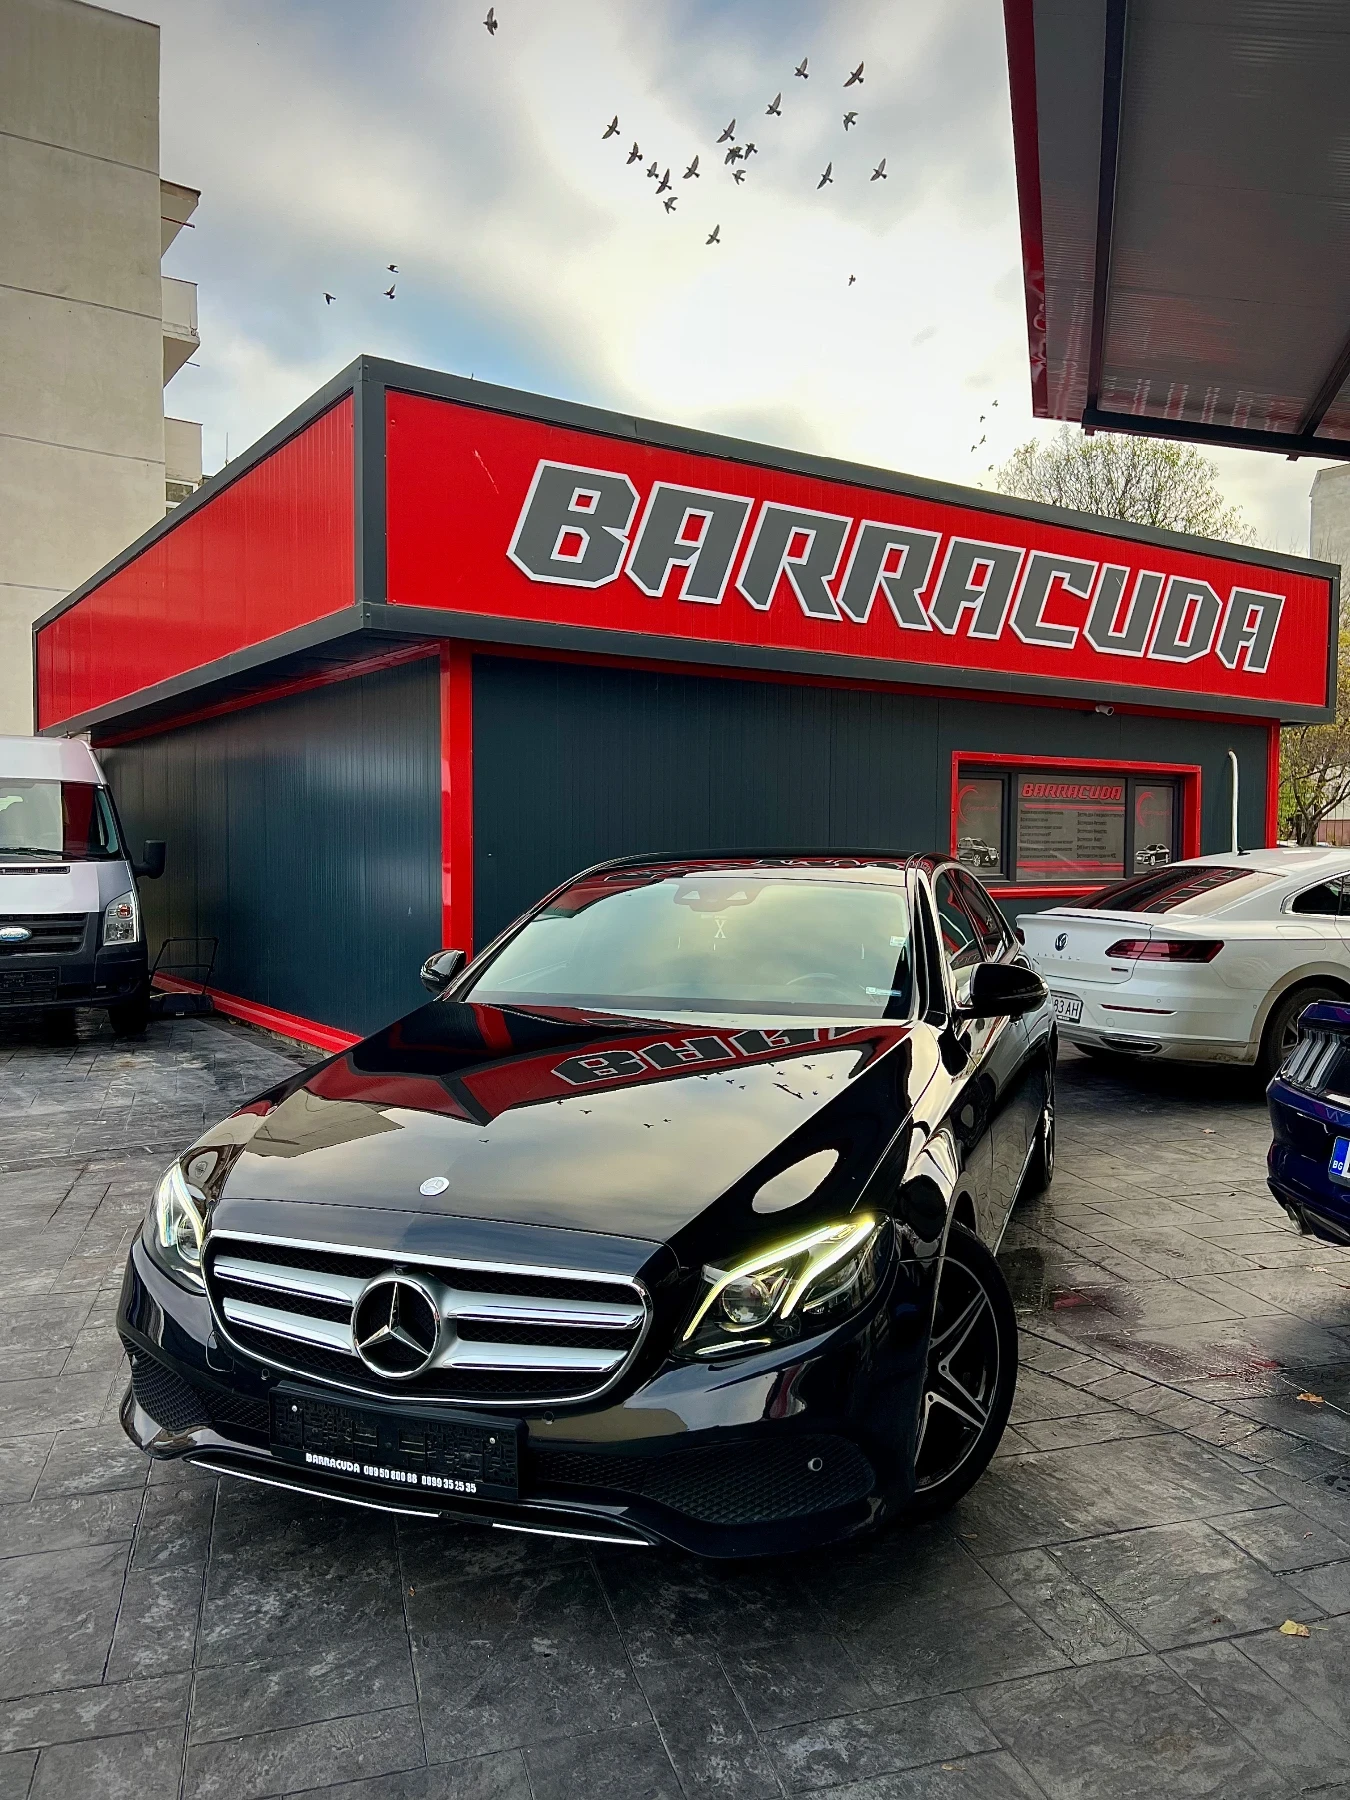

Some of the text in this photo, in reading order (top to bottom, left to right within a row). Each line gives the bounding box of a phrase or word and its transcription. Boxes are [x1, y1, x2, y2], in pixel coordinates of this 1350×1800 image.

[505, 458, 1286, 674] BARRACUDA
[1022, 783, 1122, 801] BARRACUDA
[1065, 1001, 1080, 1017] AH
[1332, 1160, 1343, 1171] BG
[305, 1452, 360, 1473] BARRACUDA
[379, 1468, 390, 1478] 50
[406, 1473, 418, 1484] 88
[443, 1478, 454, 1490] 35
[454, 1480, 465, 1491] 25
[465, 1482, 477, 1493] 35
